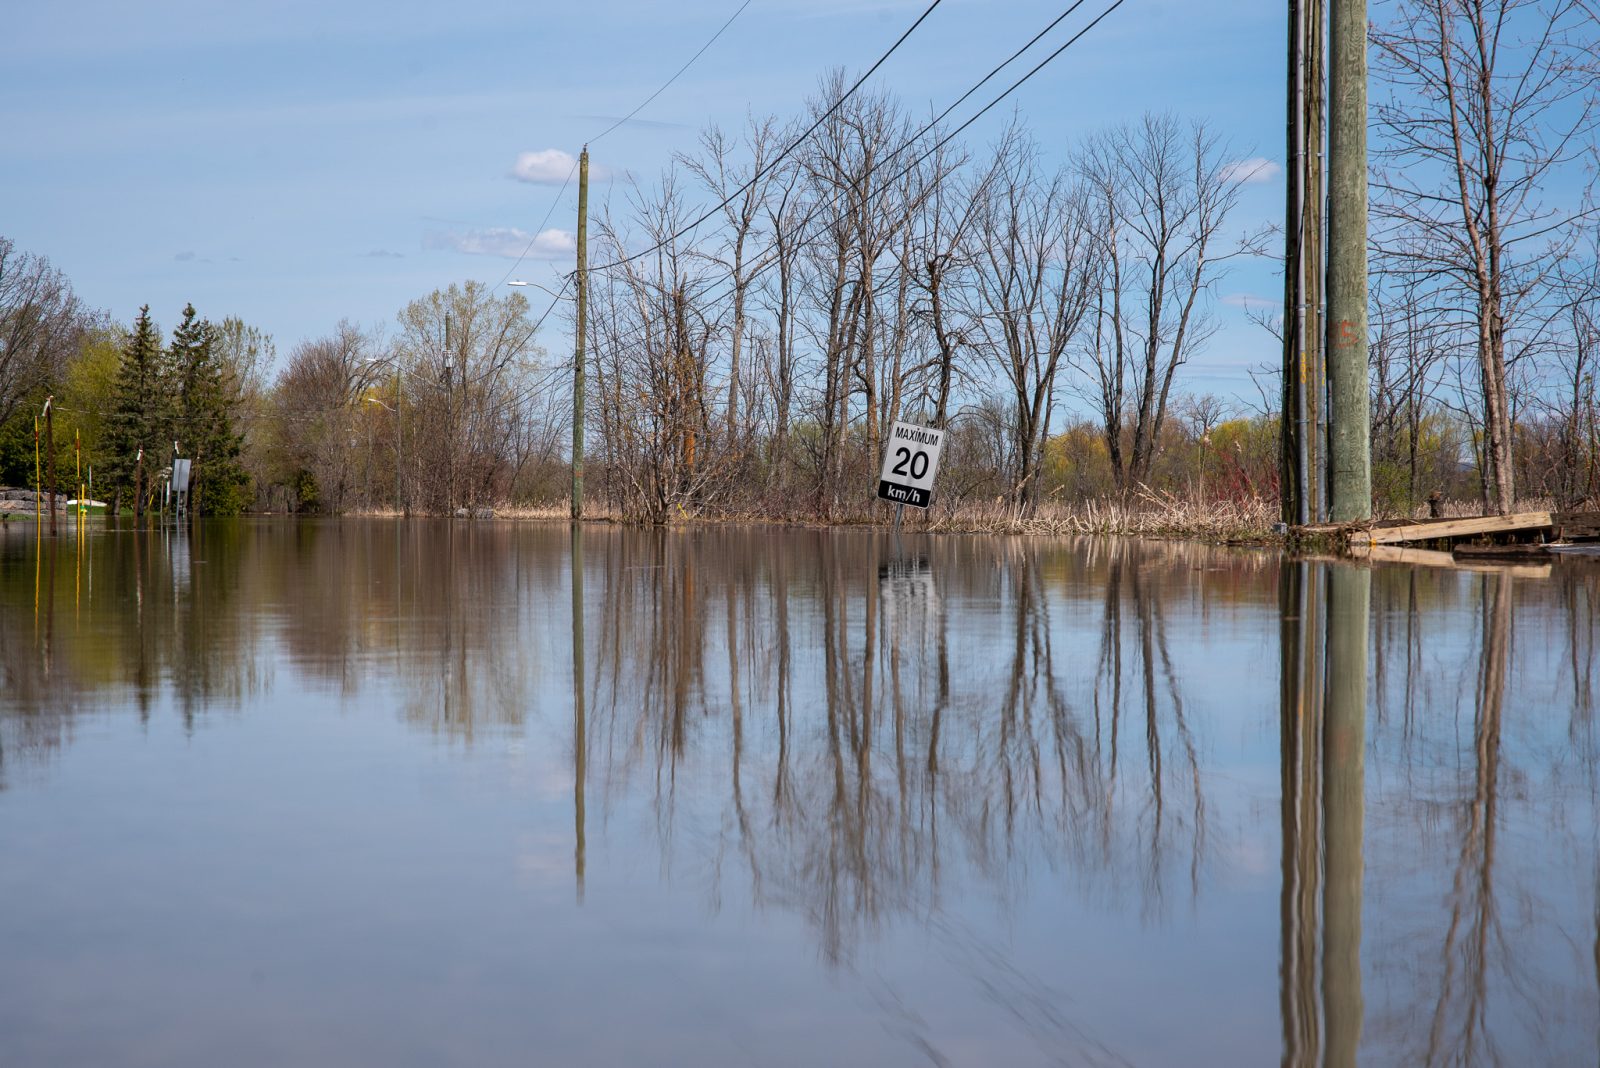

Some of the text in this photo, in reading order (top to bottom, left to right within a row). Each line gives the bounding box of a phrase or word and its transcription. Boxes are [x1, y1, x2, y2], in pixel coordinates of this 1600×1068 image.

[895, 427, 939, 446] MAXIMUM
[891, 447, 929, 480] 20
[887, 484, 921, 503] km/h
